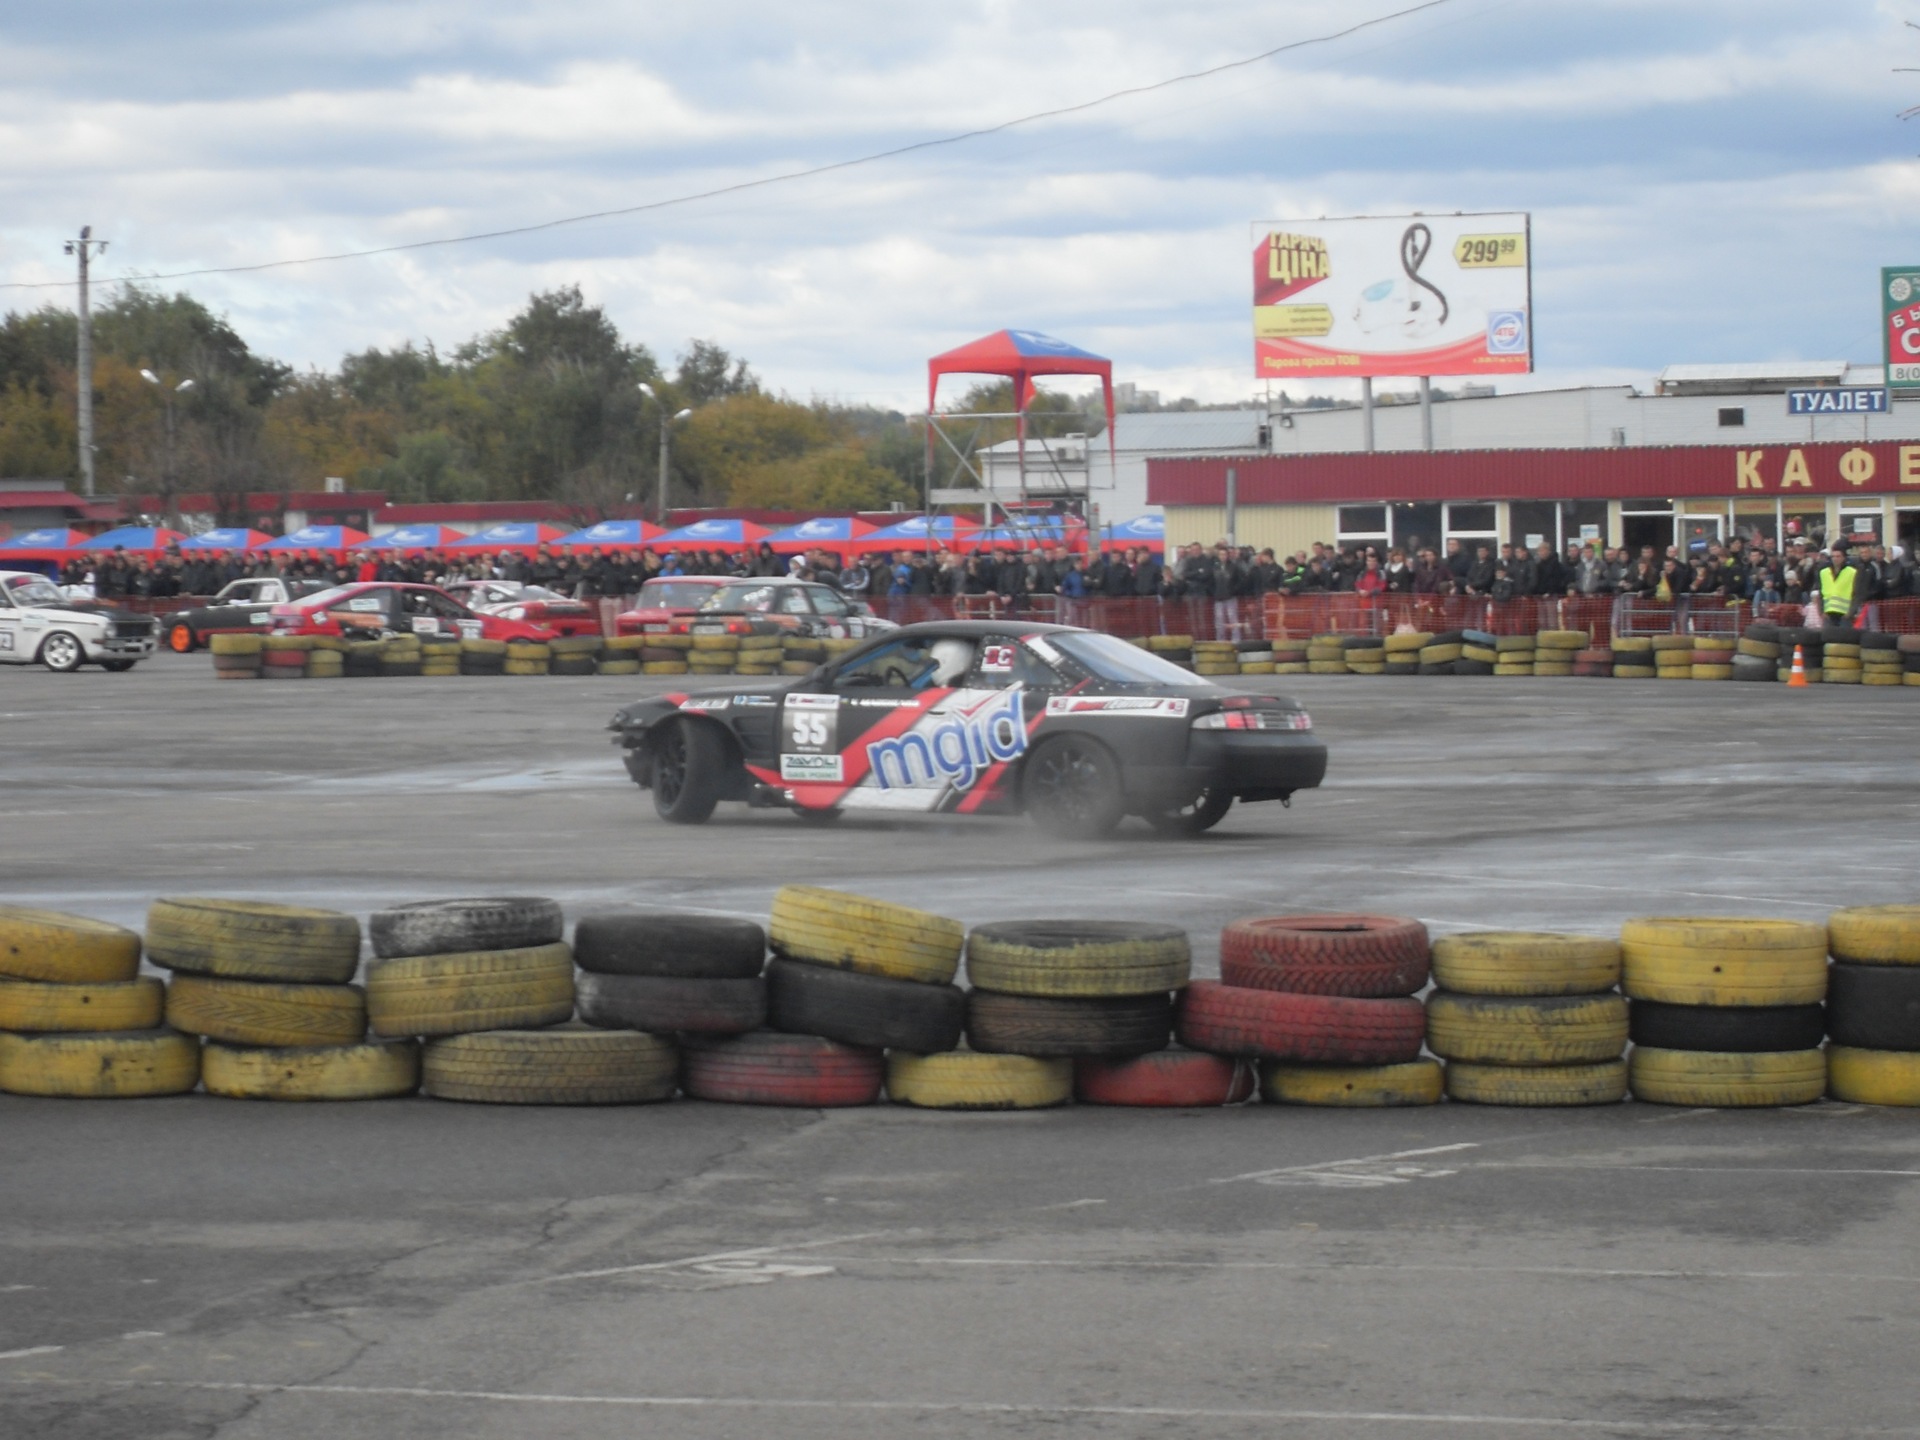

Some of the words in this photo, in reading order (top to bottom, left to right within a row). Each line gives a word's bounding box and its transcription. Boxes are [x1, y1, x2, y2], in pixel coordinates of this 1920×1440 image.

[1269, 231, 1327, 252] ГАРЯЧА
[1461, 239, 1499, 263] 299
[1269, 248, 1331, 285] ЦІНА
[1792, 391, 1884, 411] ТУАЛЕТ
[792, 712, 828, 745] 55
[867, 690, 1029, 791] mgid
